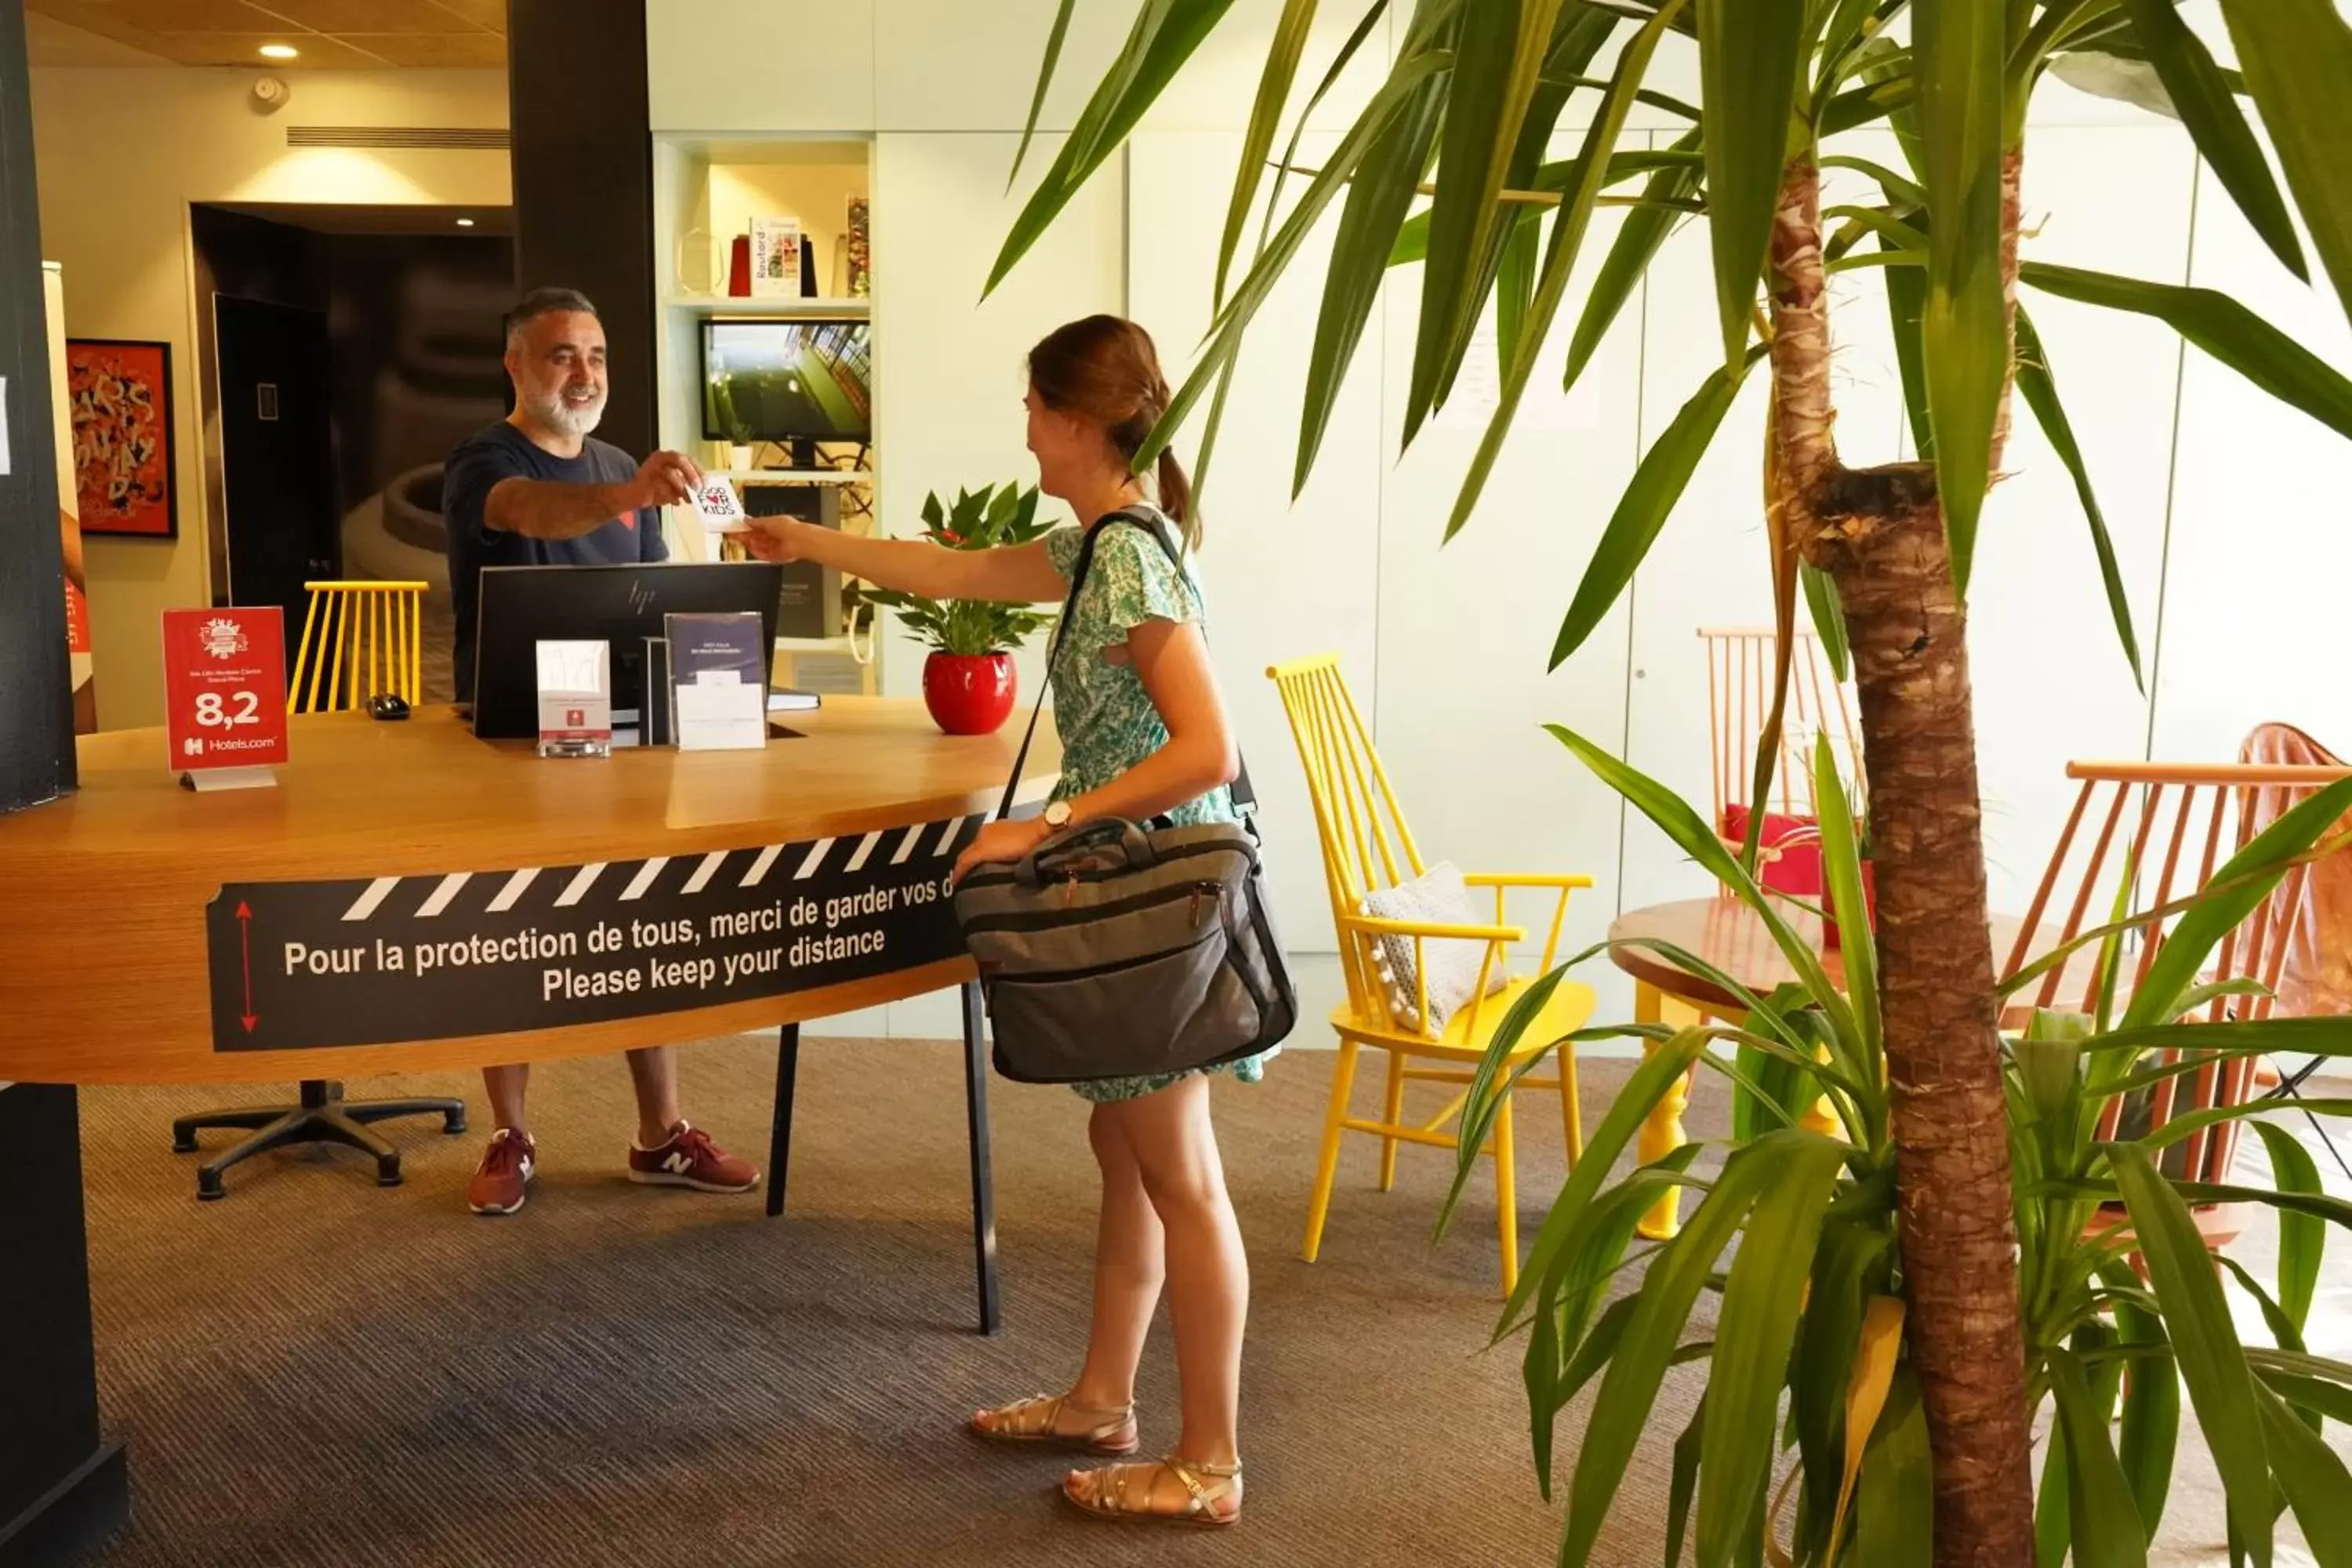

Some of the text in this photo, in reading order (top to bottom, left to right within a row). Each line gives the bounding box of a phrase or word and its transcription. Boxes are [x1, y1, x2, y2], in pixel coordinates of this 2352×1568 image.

[195, 691, 260, 731] 8,2
[209, 739, 275, 751] Hotels.com
[285, 942, 366, 975] Pour
[376, 938, 405, 971] la
[415, 927, 577, 977] protection
[587, 921, 622, 953] de
[631, 918, 701, 948] tous,
[710, 900, 782, 938] merci
[789, 897, 818, 927] de
[826, 884, 896, 928] garder
[902, 879, 937, 906] vos
[543, 929, 885, 1001] Please keep your distance
